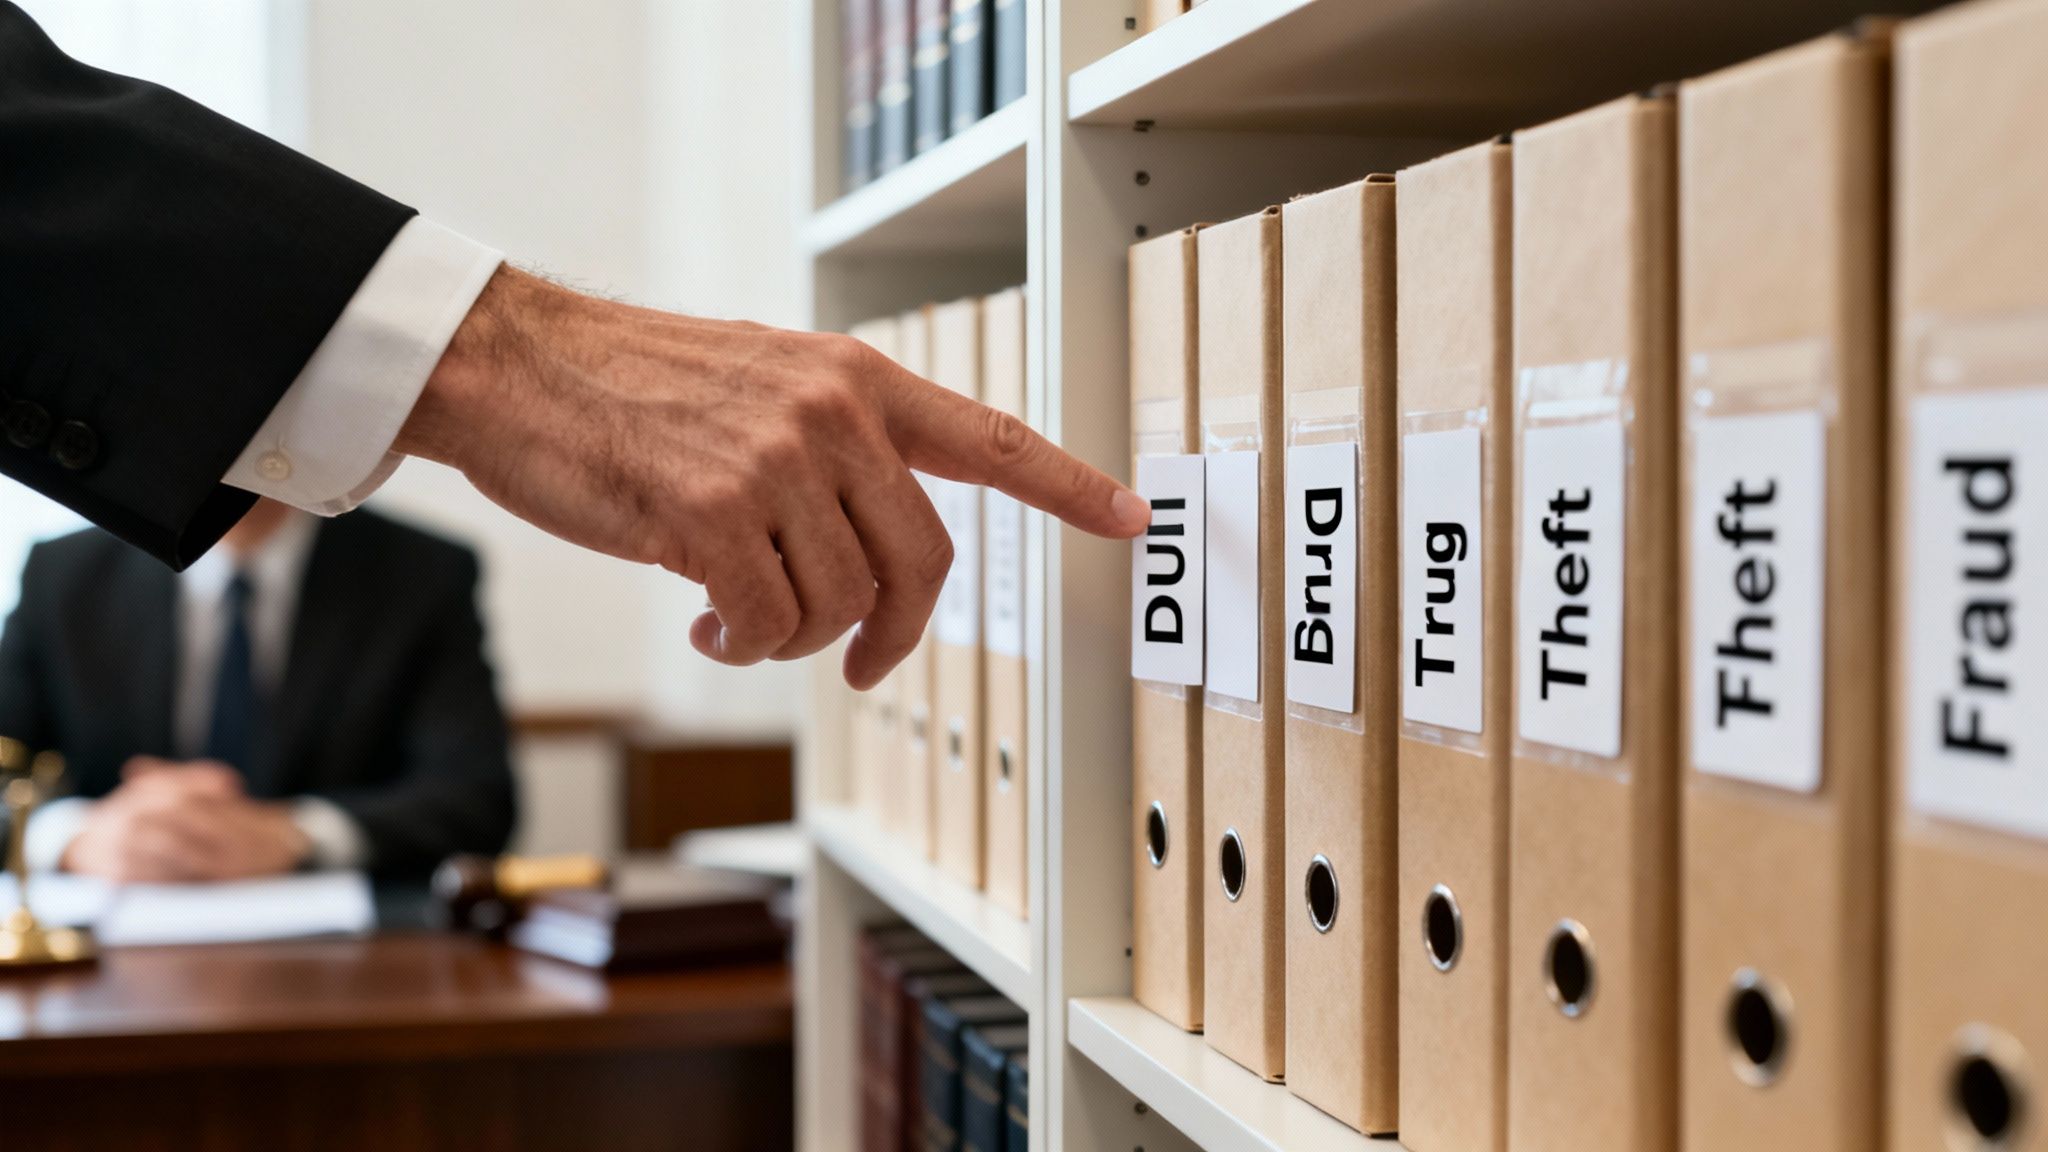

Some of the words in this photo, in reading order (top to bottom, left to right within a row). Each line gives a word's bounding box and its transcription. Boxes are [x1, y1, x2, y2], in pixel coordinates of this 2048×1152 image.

[1415, 522, 1468, 687] Trug
[1540, 489, 1591, 701] Theft
[1941, 457, 2015, 759] Fraud
